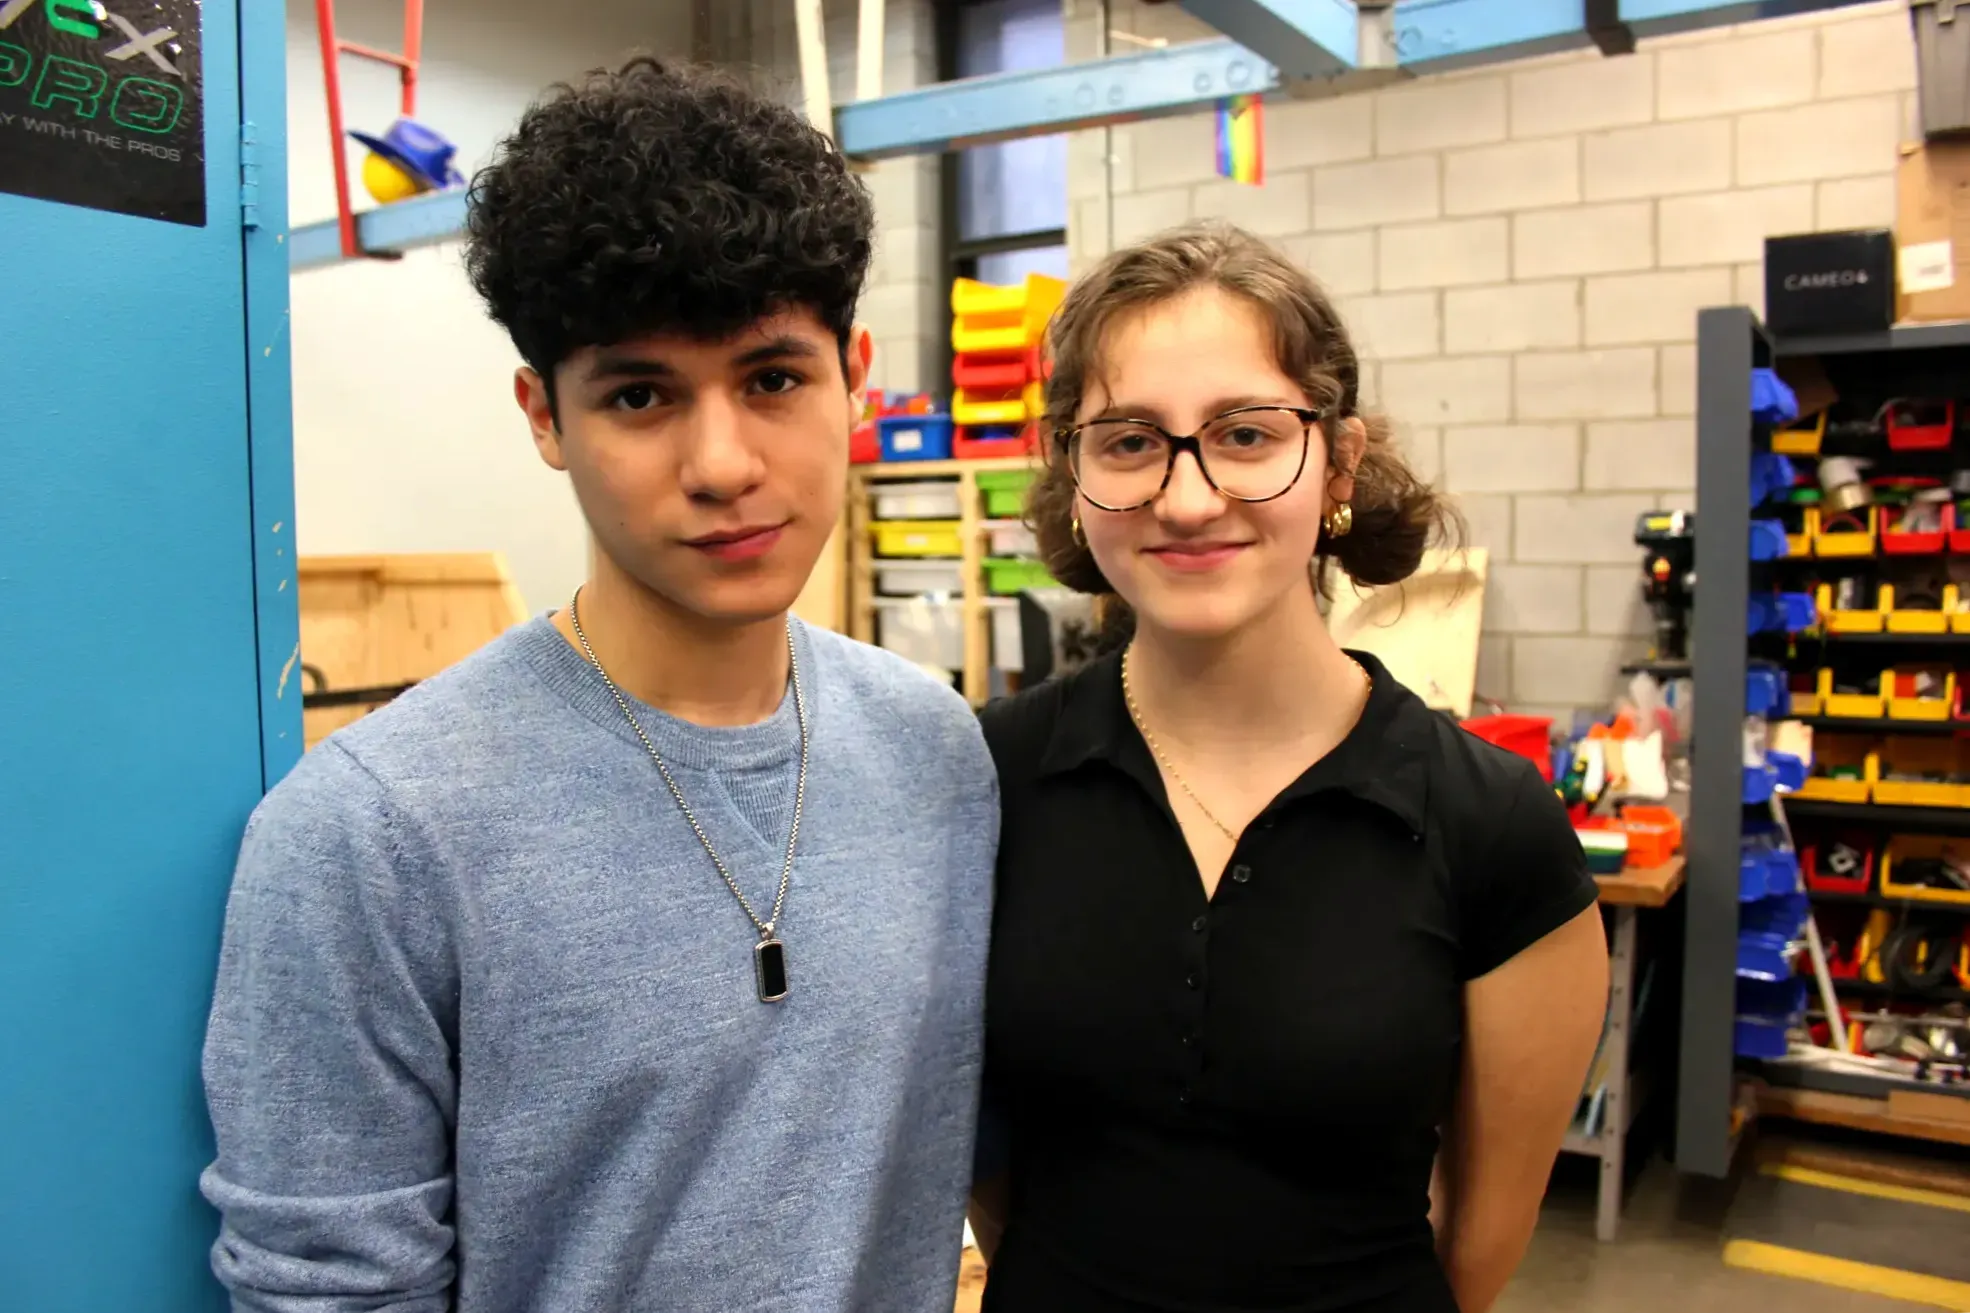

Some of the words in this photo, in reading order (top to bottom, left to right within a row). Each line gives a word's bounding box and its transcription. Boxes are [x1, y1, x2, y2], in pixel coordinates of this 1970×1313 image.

[22, 116, 77, 140] WITH
[82, 129, 123, 150] THE
[127, 139, 182, 163] PROS
